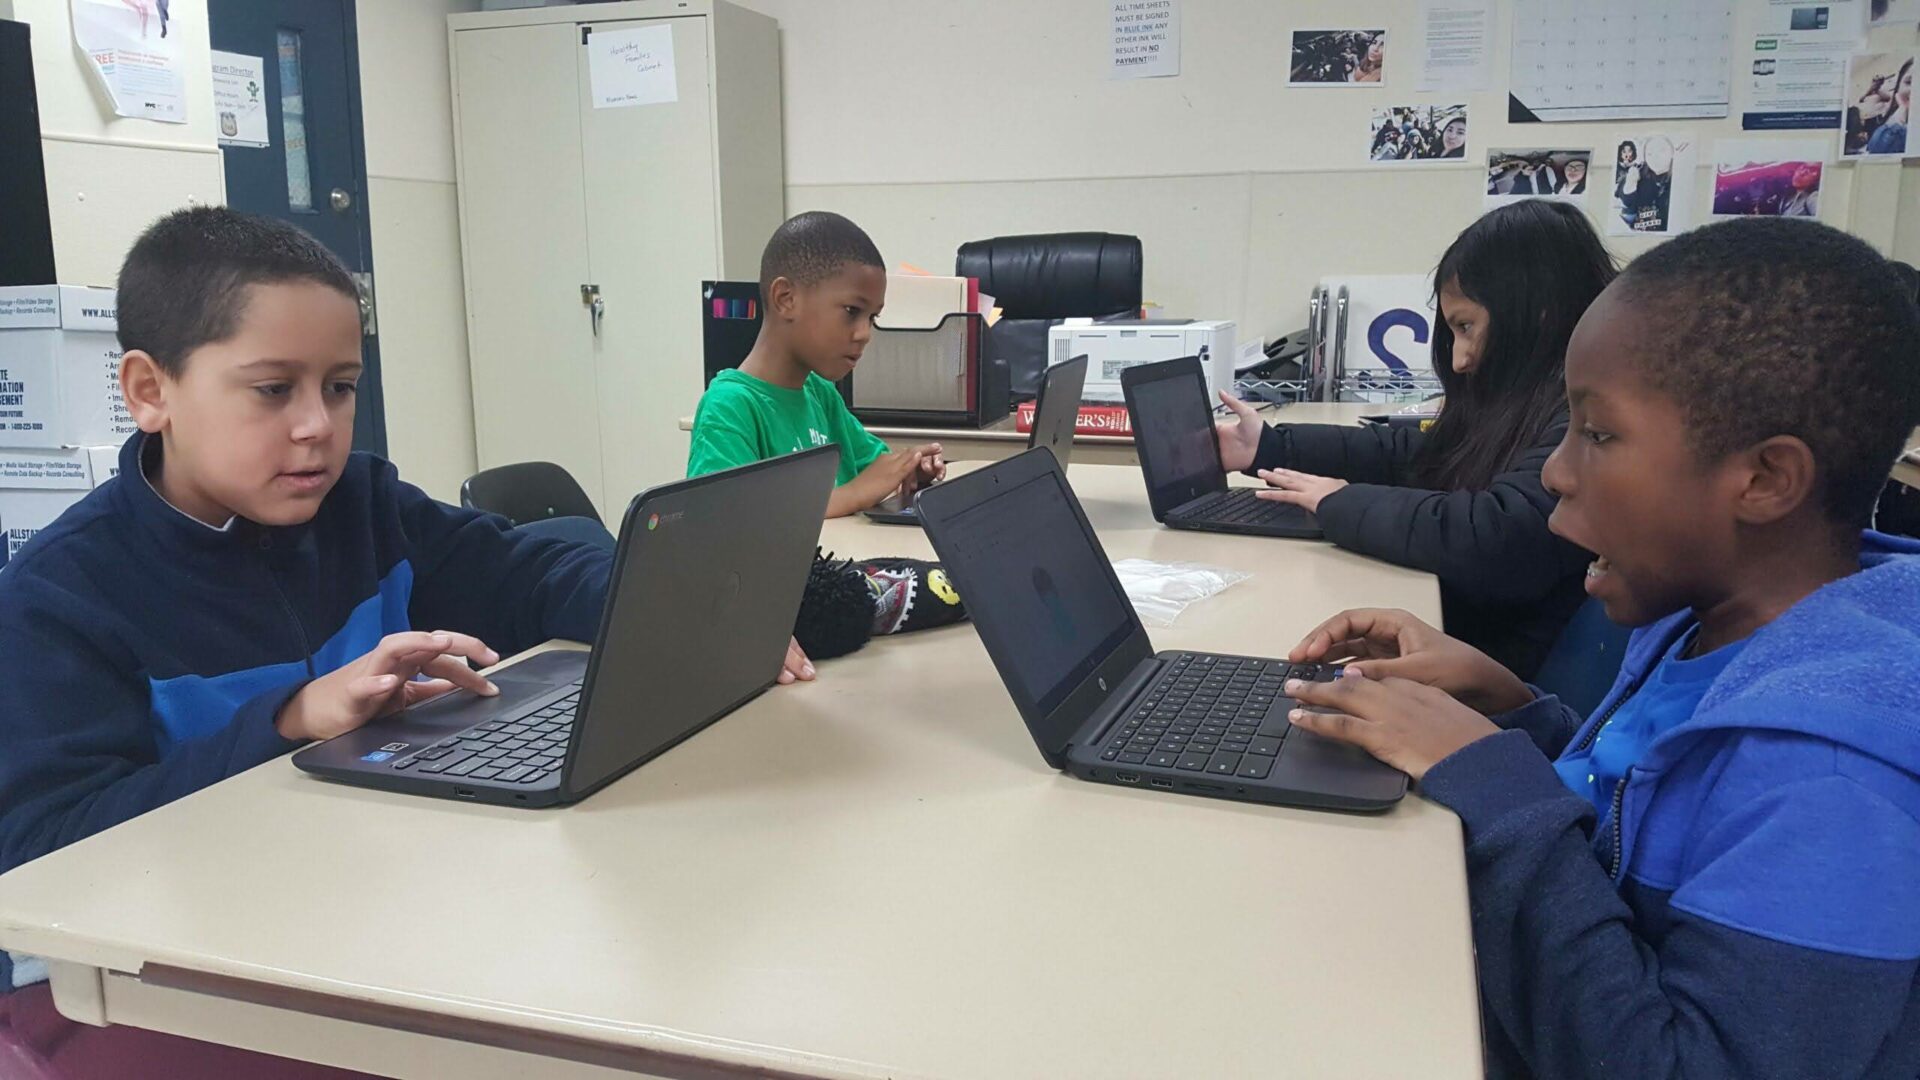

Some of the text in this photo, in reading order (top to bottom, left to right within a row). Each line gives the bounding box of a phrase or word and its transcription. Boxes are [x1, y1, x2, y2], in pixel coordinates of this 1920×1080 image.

[1115, 0, 1170, 12] ALL TIME SHEETS
[1115, 15, 1134, 23] MUST
[1145, 11, 1170, 20] SIGNED
[1124, 24, 1140, 33] BLUE
[1141, 24, 1153, 32] INK
[1154, 22, 1168, 30] ANY
[1115, 36, 1137, 44] OTHER
[1150, 33, 1167, 41] WILL
[1115, 46, 1139, 54] RESULT
[1148, 44, 1160, 53] NO
[95, 52, 115, 64] REE
